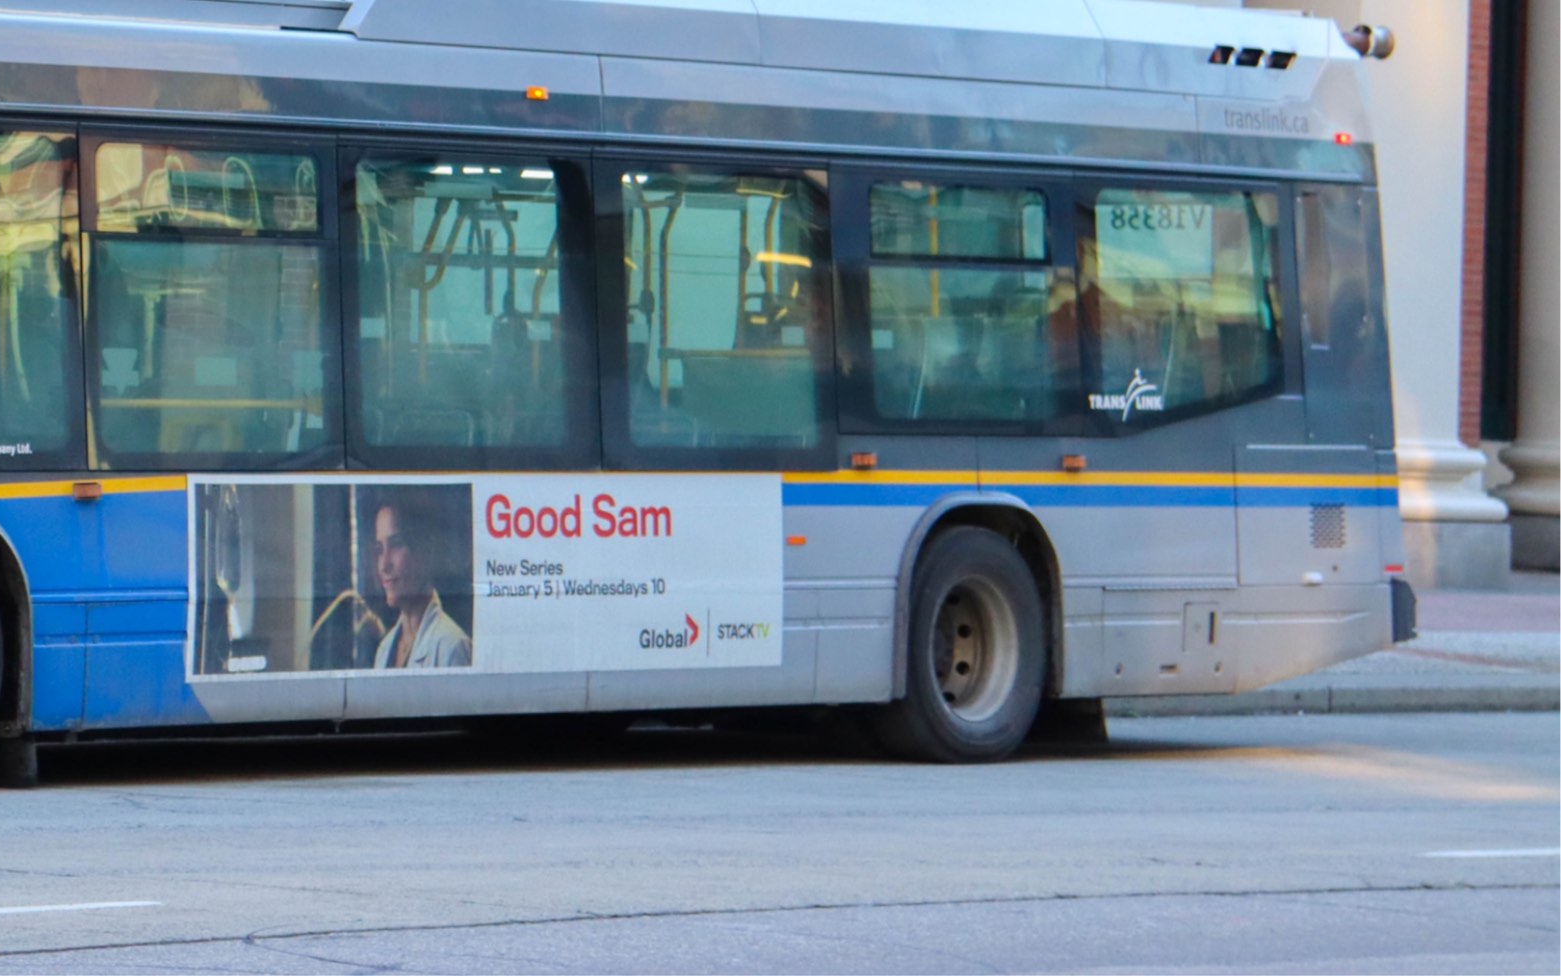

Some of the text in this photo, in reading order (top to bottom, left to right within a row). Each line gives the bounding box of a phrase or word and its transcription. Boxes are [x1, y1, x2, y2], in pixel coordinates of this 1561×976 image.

[1224, 108, 1309, 133] translink.ca
[17, 443, 33, 454] Ltd.
[485, 493, 672, 539] Good Sam
[486, 559, 564, 576] New Series
[486, 580, 540, 600] January
[544, 580, 553, 596] 5
[563, 578, 648, 599] Wednesdays
[651, 578, 666, 595] 10
[639, 628, 689, 649] Global
[717, 622, 770, 640] STACKTV
